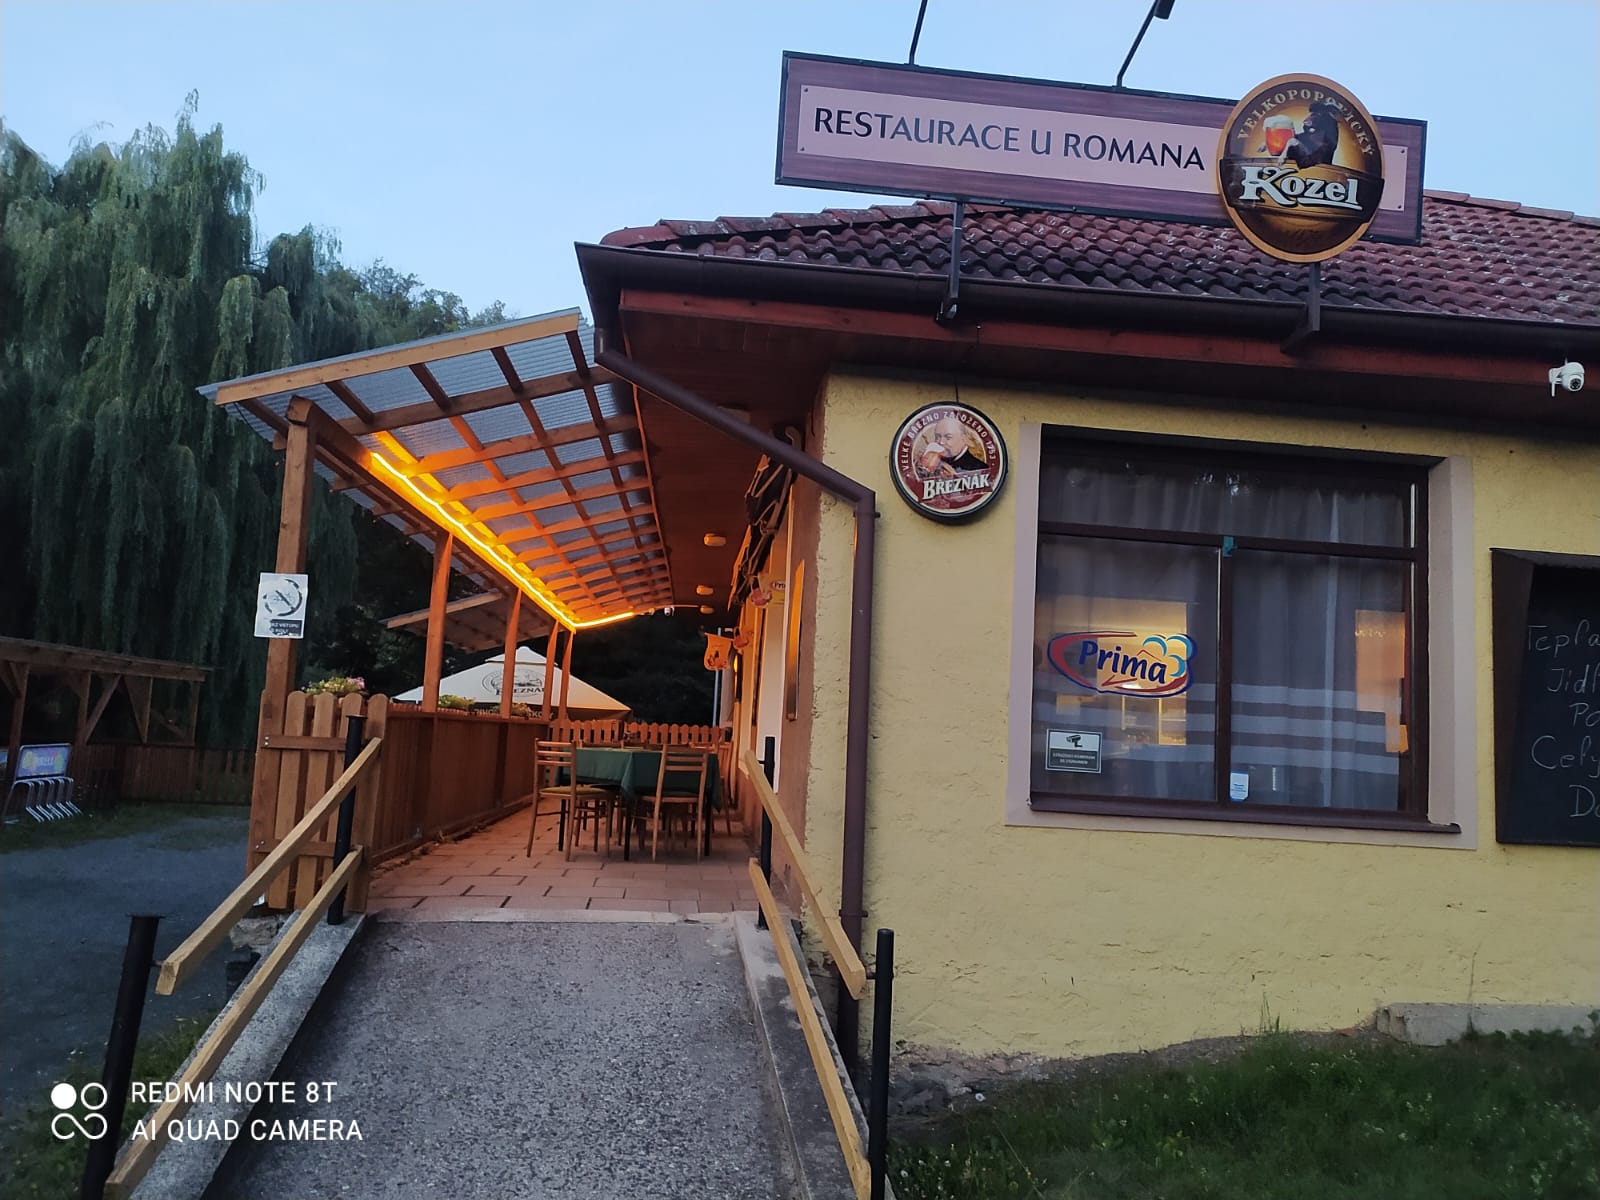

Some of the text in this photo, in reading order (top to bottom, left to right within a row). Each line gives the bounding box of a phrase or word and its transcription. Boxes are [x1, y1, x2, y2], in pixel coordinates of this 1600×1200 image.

[814, 107, 1205, 171] RESTAURACE U ROMANA
[1239, 166, 1360, 207] Kozel
[1078, 640, 1167, 684] Prima
